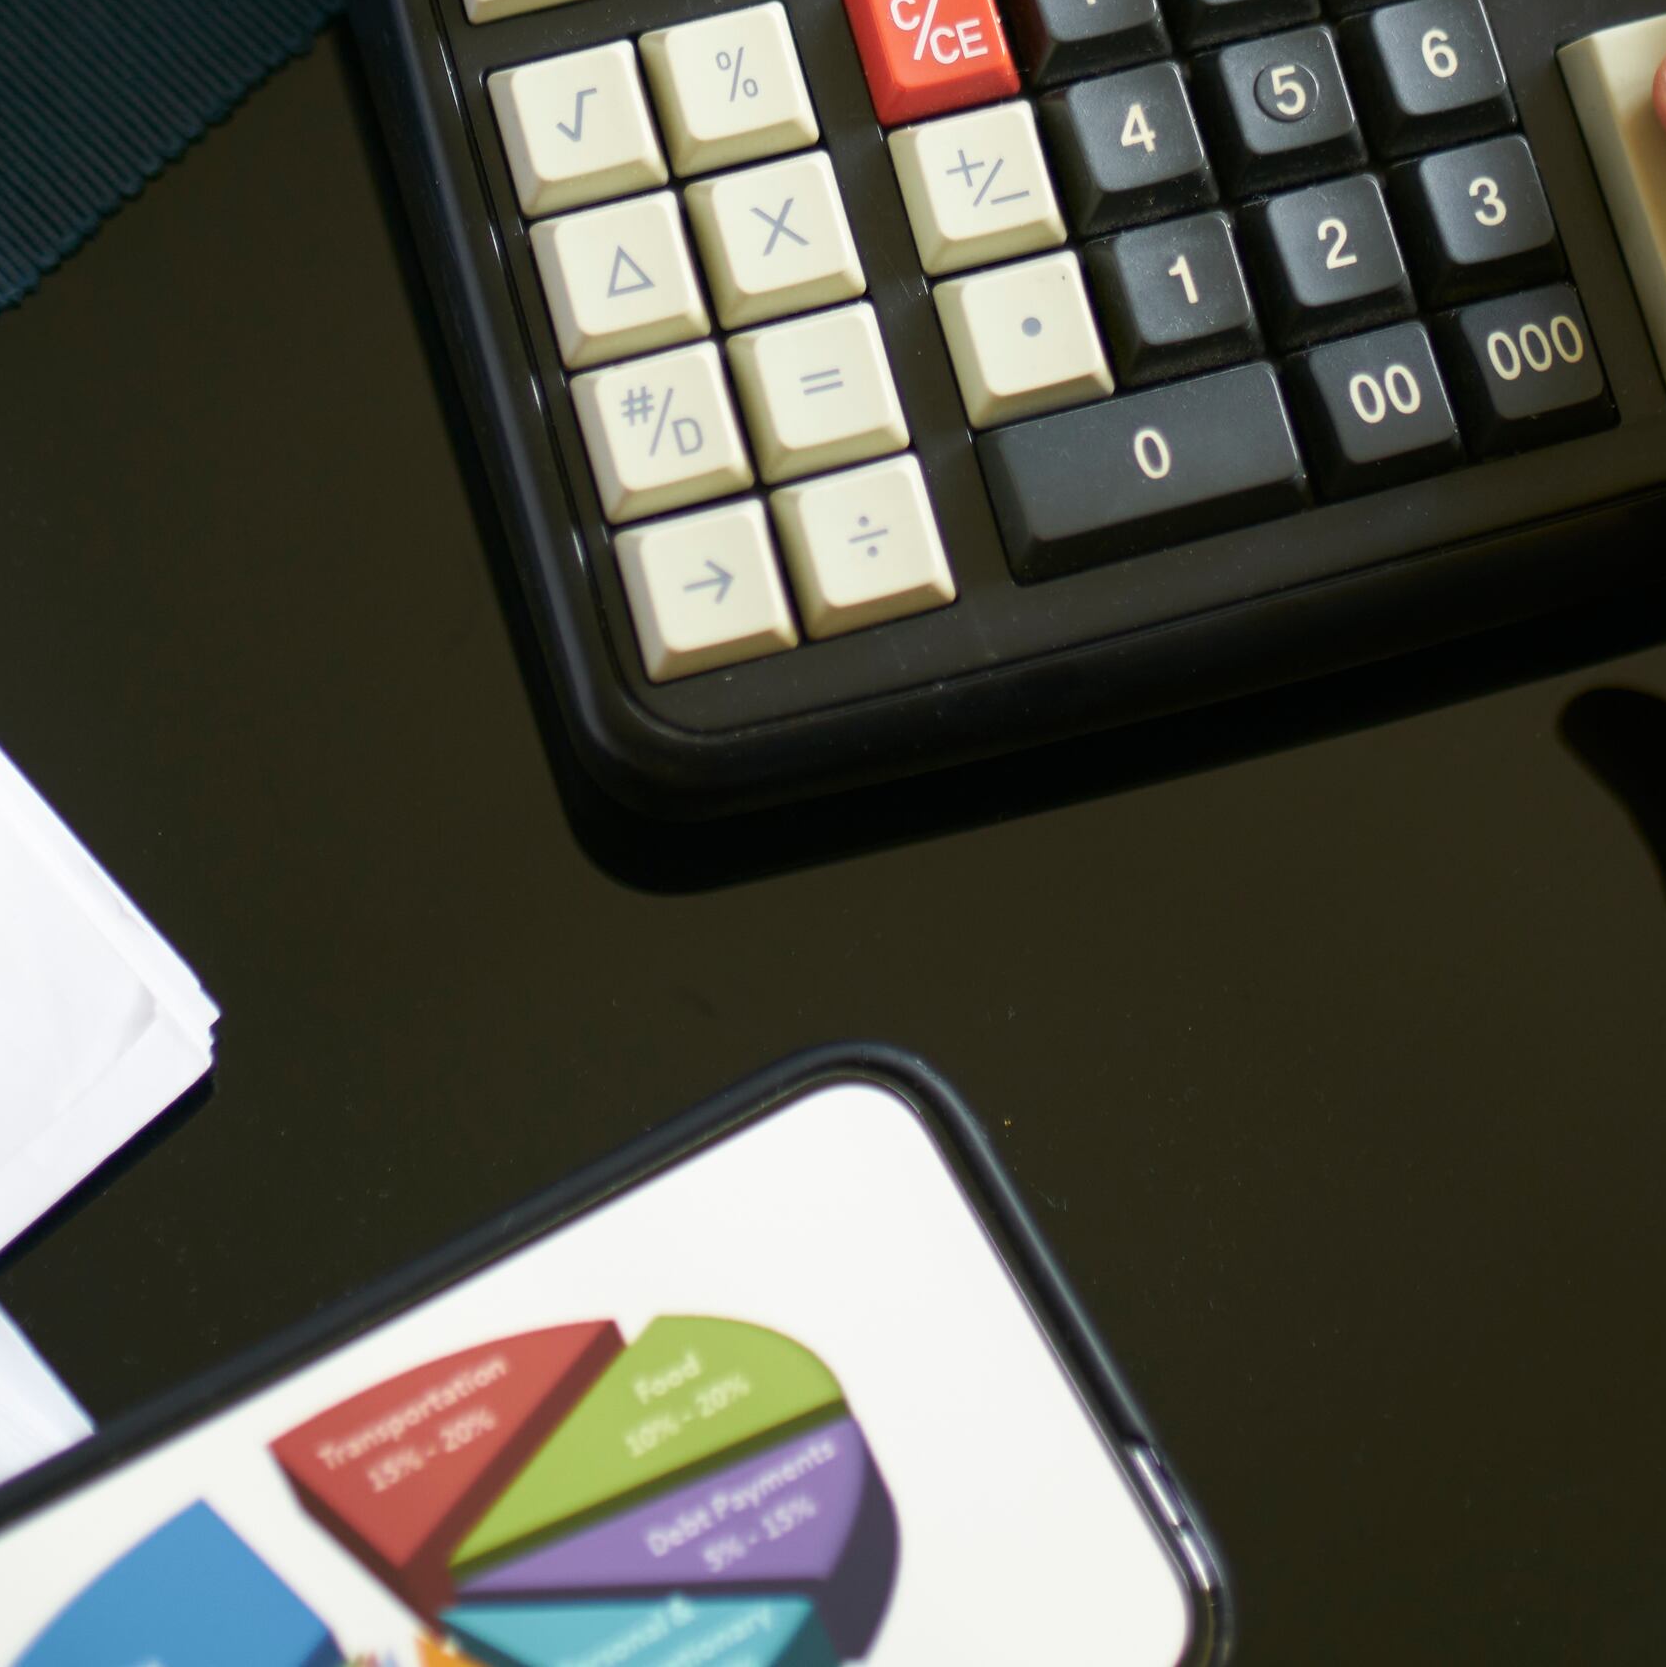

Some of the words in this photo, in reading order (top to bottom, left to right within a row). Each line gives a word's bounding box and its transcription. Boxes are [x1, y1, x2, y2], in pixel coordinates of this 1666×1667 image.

[1421, 29, 1458, 78] 6
[1270, 65, 1307, 115] 5
[1119, 103, 1157, 153] 4
[1469, 176, 1507, 227] 3
[1317, 218, 1358, 270] 2
[1168, 255, 1199, 304] 1
[1487, 315, 1583, 381] 000
[1349, 363, 1422, 424] 00
[1133, 428, 1170, 480] 0
[635, 1351, 700, 1405] Food
[694, 1373, 751, 1419] 20%
[316, 1354, 506, 1470] Transportation
[438, 1407, 497, 1454] 20%
[645, 1505, 713, 1558] Debt
[711, 1438, 836, 1522] Payments
